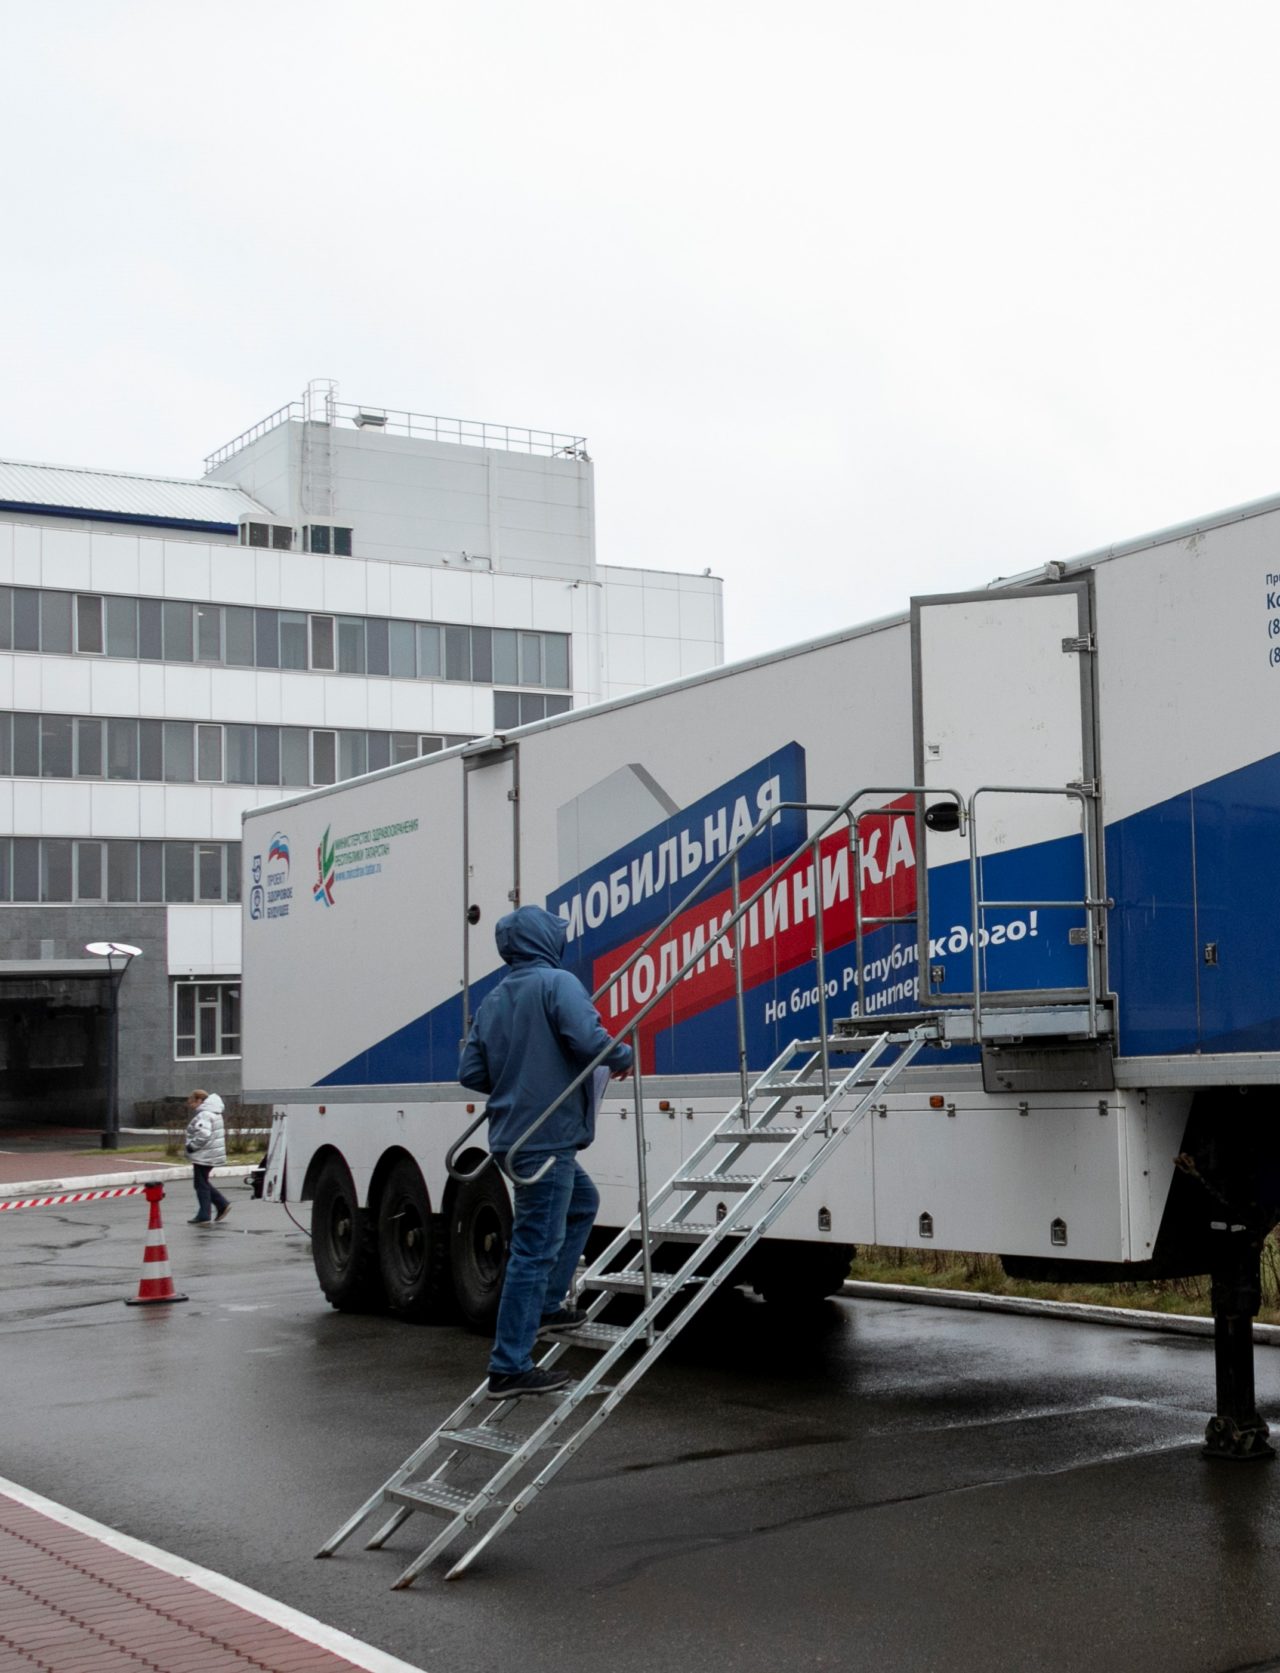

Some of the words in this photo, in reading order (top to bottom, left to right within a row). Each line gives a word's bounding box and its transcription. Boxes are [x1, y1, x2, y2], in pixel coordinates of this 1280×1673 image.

[557, 774, 782, 943] МОБИЛЬНАЯ
[608, 815, 916, 1018] ПОЛИКЛИНИКА
[765, 999, 787, 1025] На
